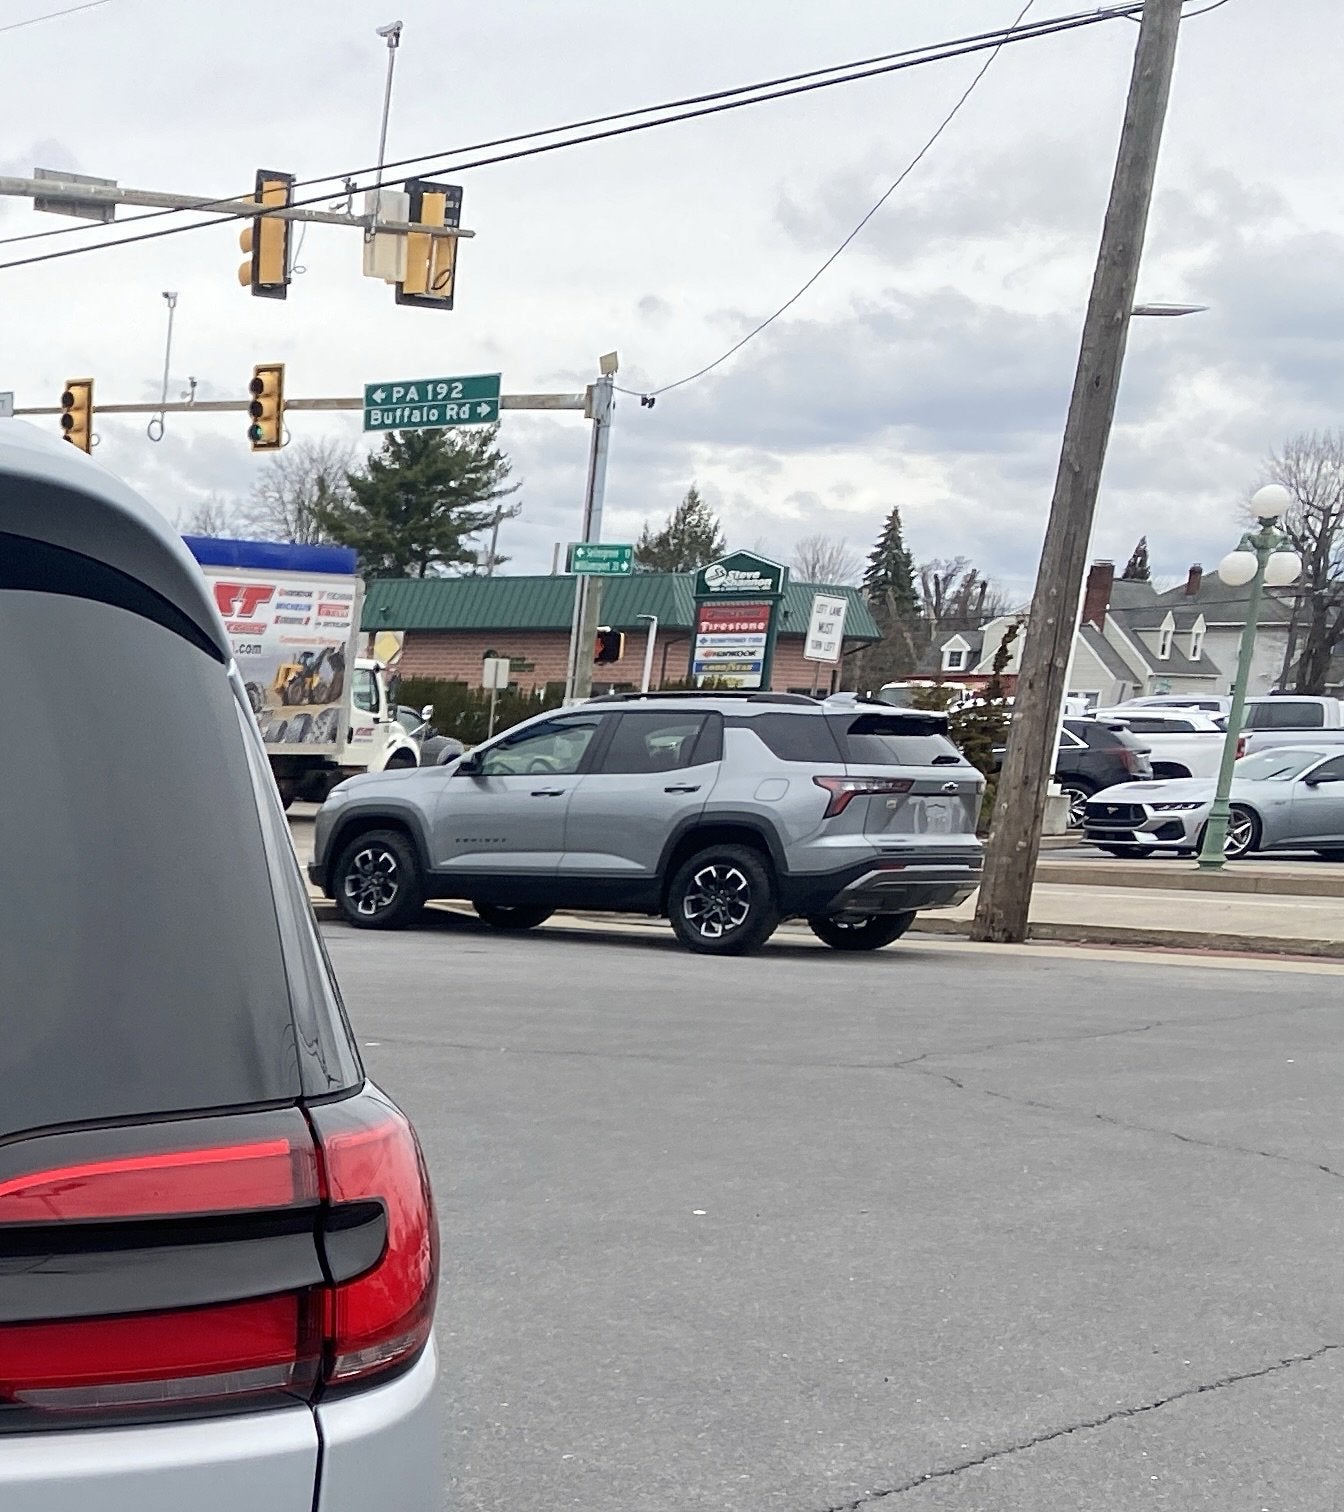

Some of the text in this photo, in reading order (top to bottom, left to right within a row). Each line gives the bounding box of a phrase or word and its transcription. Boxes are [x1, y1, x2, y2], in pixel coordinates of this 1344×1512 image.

[392, 382, 463, 403] PA 192
[370, 403, 471, 425] Buffalo Rd
[728, 570, 761, 580] Steve
[700, 621, 766, 632] Firestone
